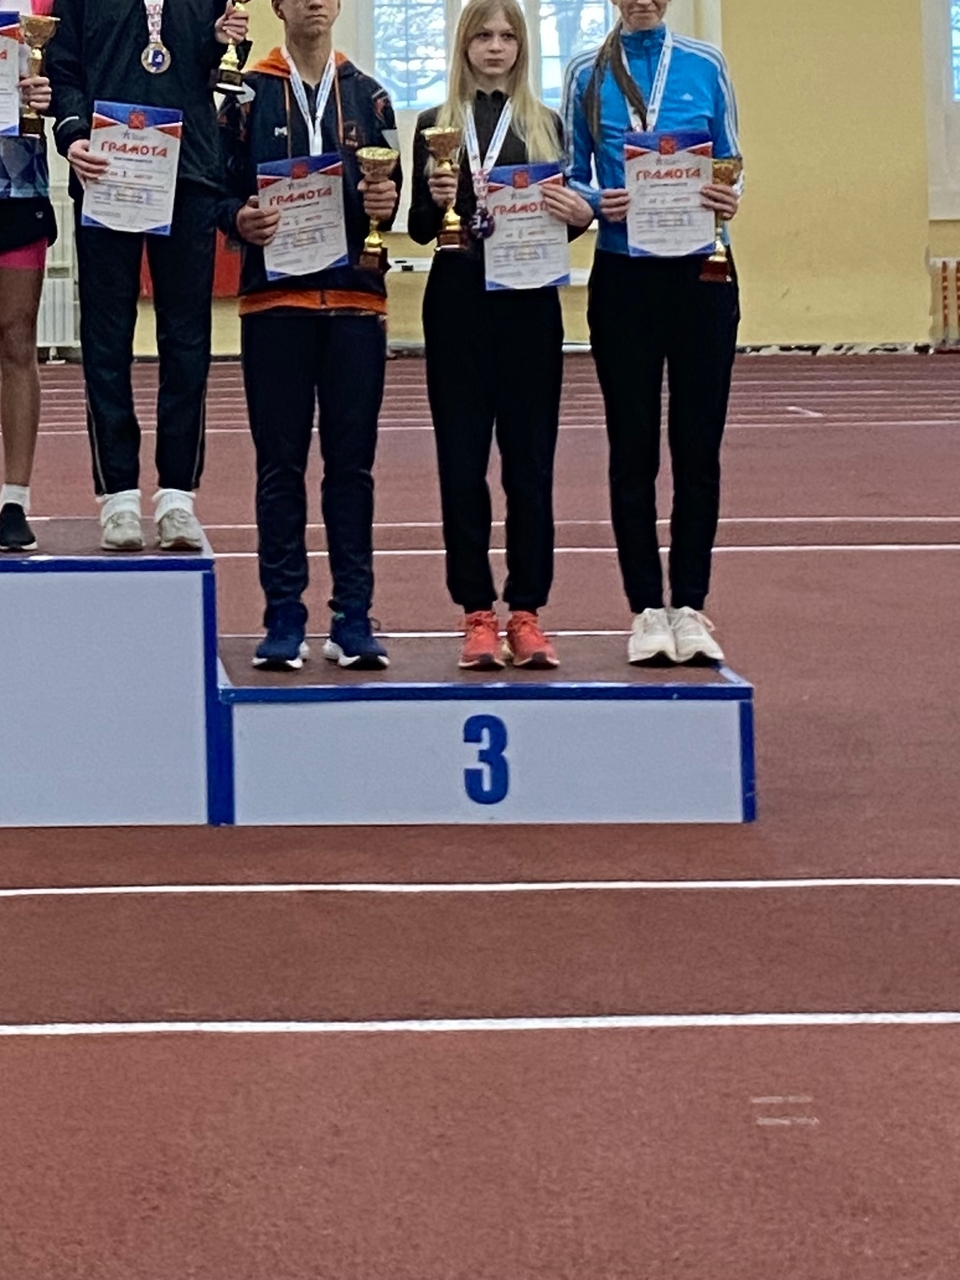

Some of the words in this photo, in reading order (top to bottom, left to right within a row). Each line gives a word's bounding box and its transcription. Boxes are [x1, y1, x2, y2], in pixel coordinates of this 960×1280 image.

[101, 141, 169, 158] ГРАМОТА
[636, 167, 701, 181] ГРАМОТА
[269, 186, 332, 206] ГРАМОТА
[493, 201, 548, 216] ГРАМОТ
[463, 714, 509, 805] 3
